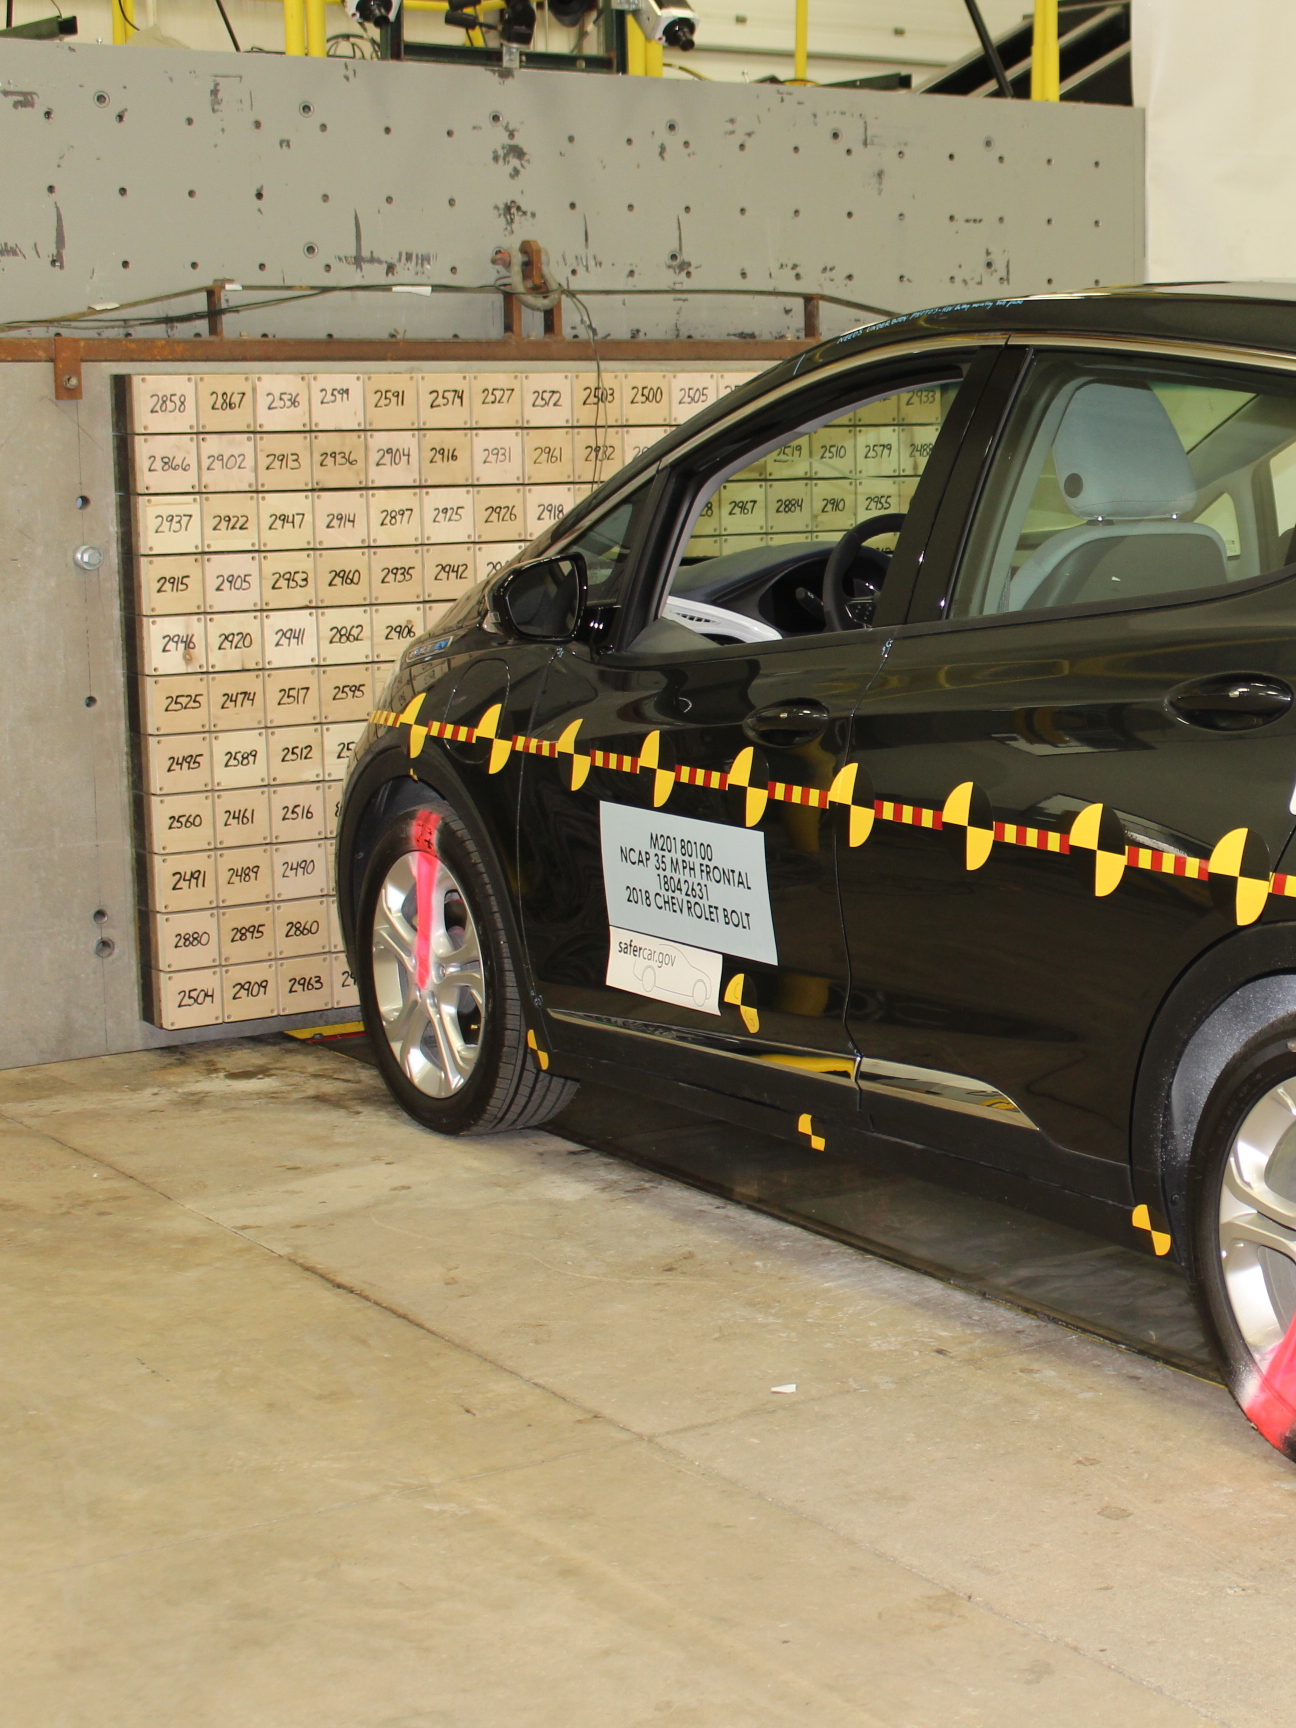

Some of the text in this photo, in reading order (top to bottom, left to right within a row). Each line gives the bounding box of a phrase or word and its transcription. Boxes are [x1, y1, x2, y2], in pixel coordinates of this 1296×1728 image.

[150, 394, 186, 414] 2858
[210, 391, 246, 411] 2867
[266, 392, 300, 410] 2536
[374, 390, 404, 408] 2591
[429, 389, 464, 409] 2574
[482, 388, 515, 405] 2527
[532, 390, 562, 407] 2572
[583, 387, 615, 405] 2503
[630, 386, 663, 404] 2500
[679, 388, 709, 405] 2505
[906, 390, 936, 406] 2933
[320, 451, 357, 467] 2936
[376, 448, 410, 467] 2904
[429, 447, 458, 463] 2916
[483, 447, 511, 464] 2931
[534, 447, 562, 464] 2961
[820, 444, 846, 459] 2510
[864, 444, 892, 459] 2579
[148, 455, 190, 472] 2866
[207, 454, 246, 471] 2902
[266, 453, 301, 470] 2913
[729, 500, 757, 515] 2967
[776, 498, 803, 513] 2884
[821, 498, 845, 513] 2910
[865, 495, 891, 510] 2955
[326, 513, 356, 529] 2914
[380, 508, 413, 526] 2897
[433, 506, 465, 523] 2925
[484, 505, 517, 523] 2926
[537, 504, 564, 520] 2918
[155, 514, 193, 533] 2937
[212, 515, 249, 531] 2922
[268, 513, 305, 530] 2947
[271, 571, 308, 590] 2953
[328, 569, 361, 587] 2960
[381, 567, 415, 584] 2935
[434, 563, 468, 581] 2942
[157, 575, 190, 593] 2915
[215, 574, 252, 591] 2905
[275, 628, 305, 647] 2941
[329, 624, 364, 644] 2862
[385, 624, 416, 639] 2906
[162, 635, 196, 653] 2946
[218, 632, 252, 650] 2920
[221, 691, 256, 709] 2474
[277, 687, 310, 706] 2517
[332, 684, 365, 701] 2595
[165, 694, 203, 712] 2525
[224, 749, 258, 768] 2589
[281, 745, 312, 762] 2512
[167, 754, 203, 773] 2495
[224, 808, 254, 827] 2461
[282, 804, 313, 821] 2516
[168, 814, 202, 830] 2560
[650, 832, 713, 862] M20180100
[227, 865, 260, 884] 2489
[282, 860, 315, 878] 2490
[620, 845, 751, 891] NCAP 35 MPH FRONTAL
[172, 870, 206, 891] 2491
[657, 873, 710, 901] 18042631
[626, 886, 751, 930] 2018 CHEVROLET BOLT
[231, 924, 265, 943] 2895
[285, 920, 319, 938] 2860
[174, 931, 210, 949] 2880
[618, 939, 677, 968] safercar.gov
[232, 980, 268, 1000] 2909
[289, 976, 323, 993] 2963
[178, 988, 214, 1008] 2504
